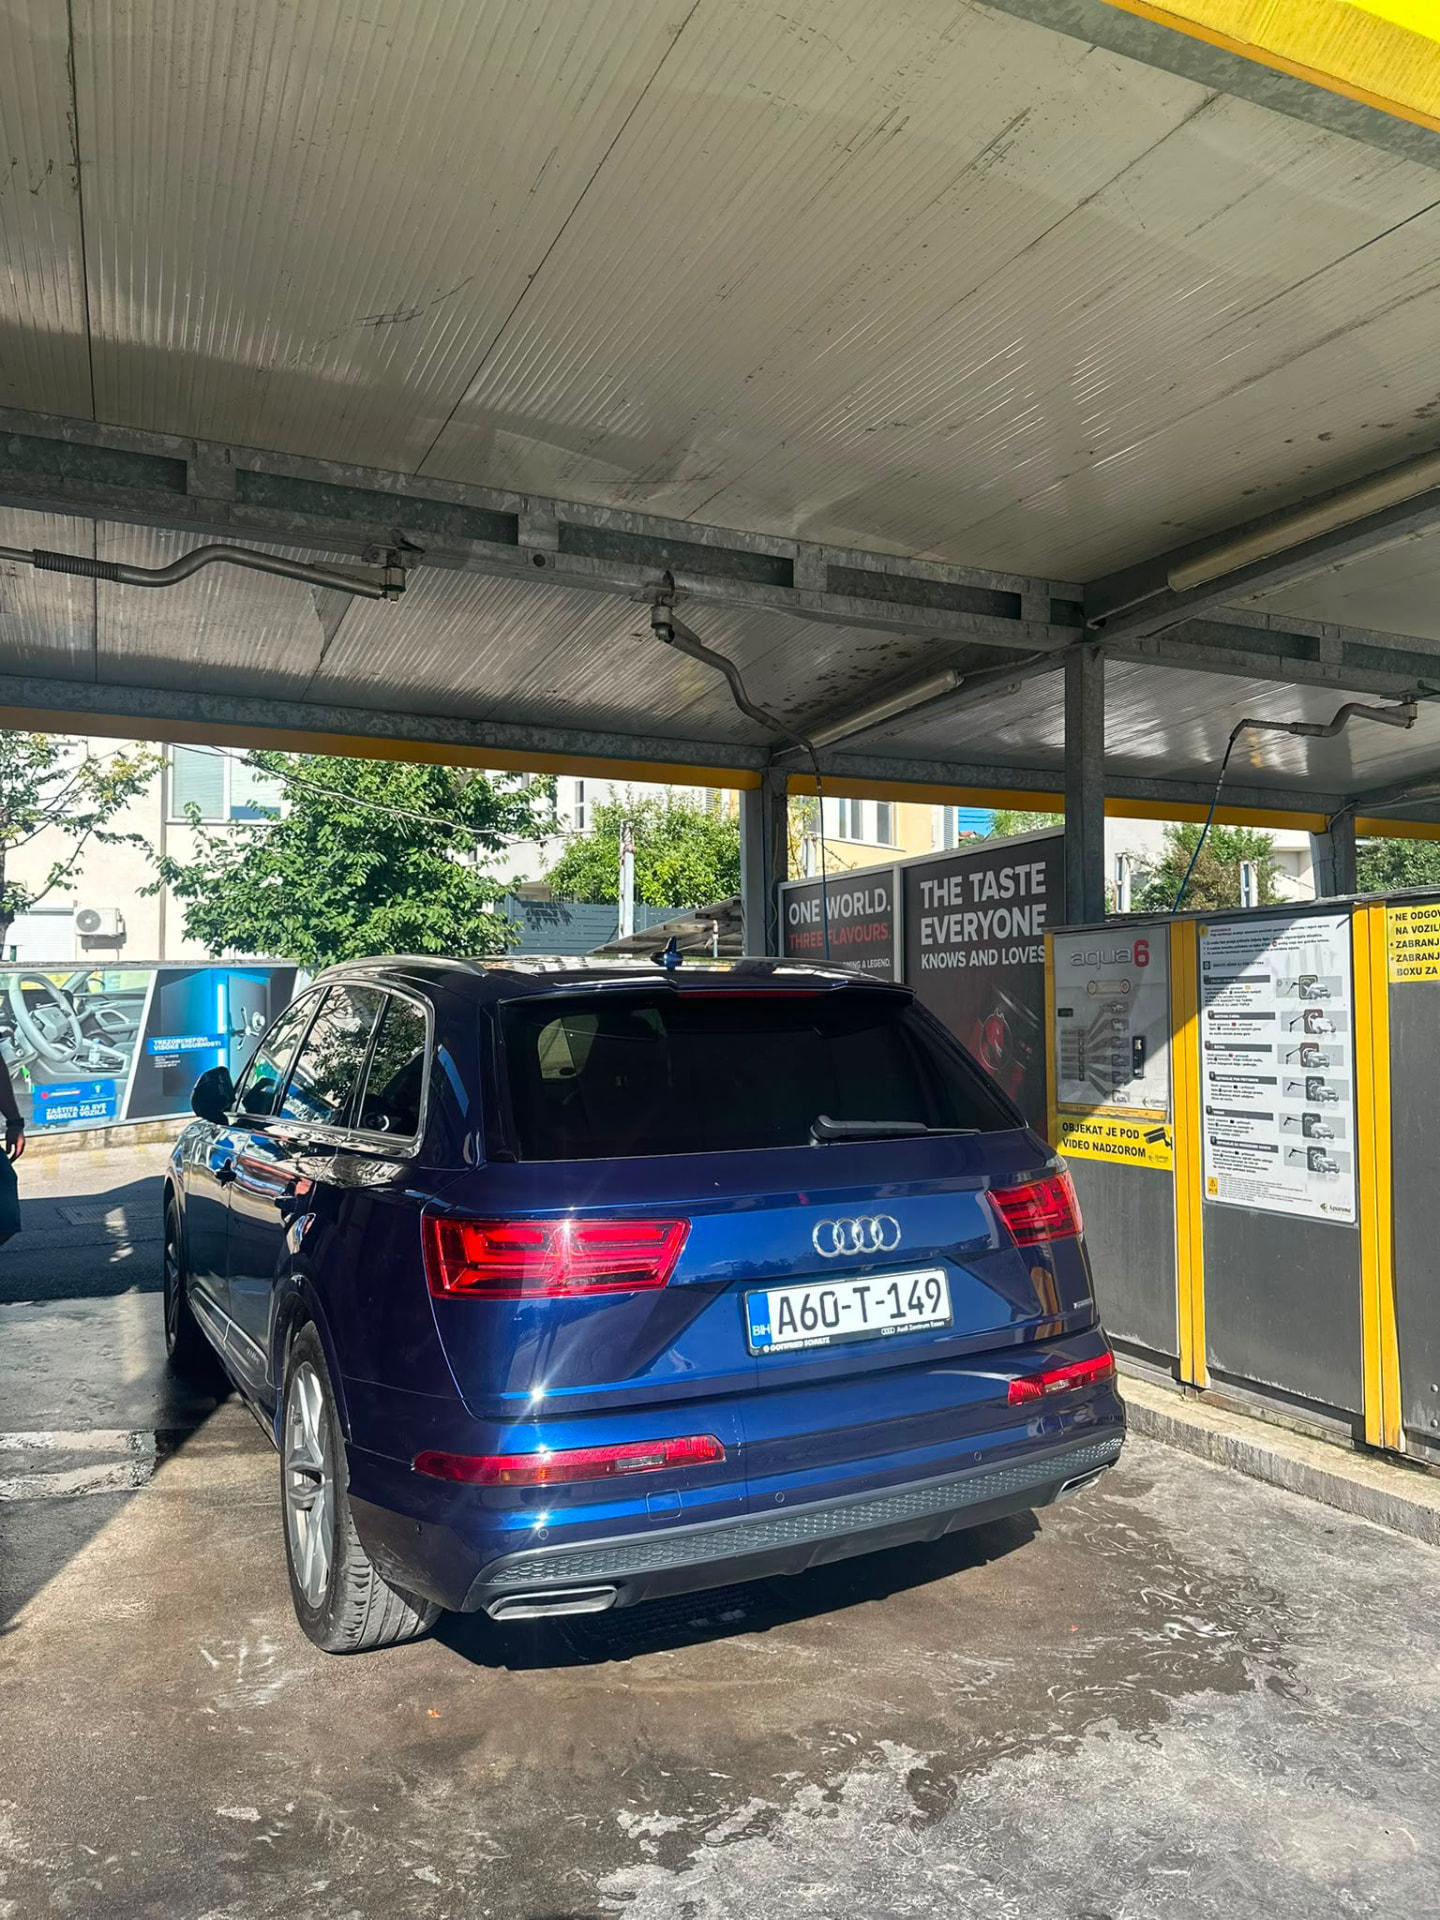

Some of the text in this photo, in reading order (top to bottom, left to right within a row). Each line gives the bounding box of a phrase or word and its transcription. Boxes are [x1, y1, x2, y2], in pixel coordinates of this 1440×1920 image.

[920, 862, 1046, 908] THE TASTE
[789, 888, 891, 925] ONE WORLD.
[921, 904, 1046, 945] EVERYONE
[1395, 913, 1407, 921] NE
[789, 923, 891, 949] THREE FLAVOURS.
[1395, 924, 1440, 935] NA VOZIL
[862, 959, 867, 969] A
[922, 945, 1045, 969] KNOWS AND LOVES
[1397, 967, 1438, 976] BOXU ZA
[46, 1105, 78, 1114] ZAŠTITA
[80, 1104, 91, 1112] ZA
[46, 1109, 106, 1120] MODELE VOZILA
[1062, 1122, 1140, 1139] OBJEKAT JE POD
[1062, 1138, 1146, 1158] VIDEO NADZOROM
[778, 1277, 942, 1336] A60-T-149
[752, 1323, 771, 1337] BIH
[896, 1320, 945, 1333] Audi Zentrum Essen
[770, 1336, 831, 1351] GOTTFRIED SCHULTZ
